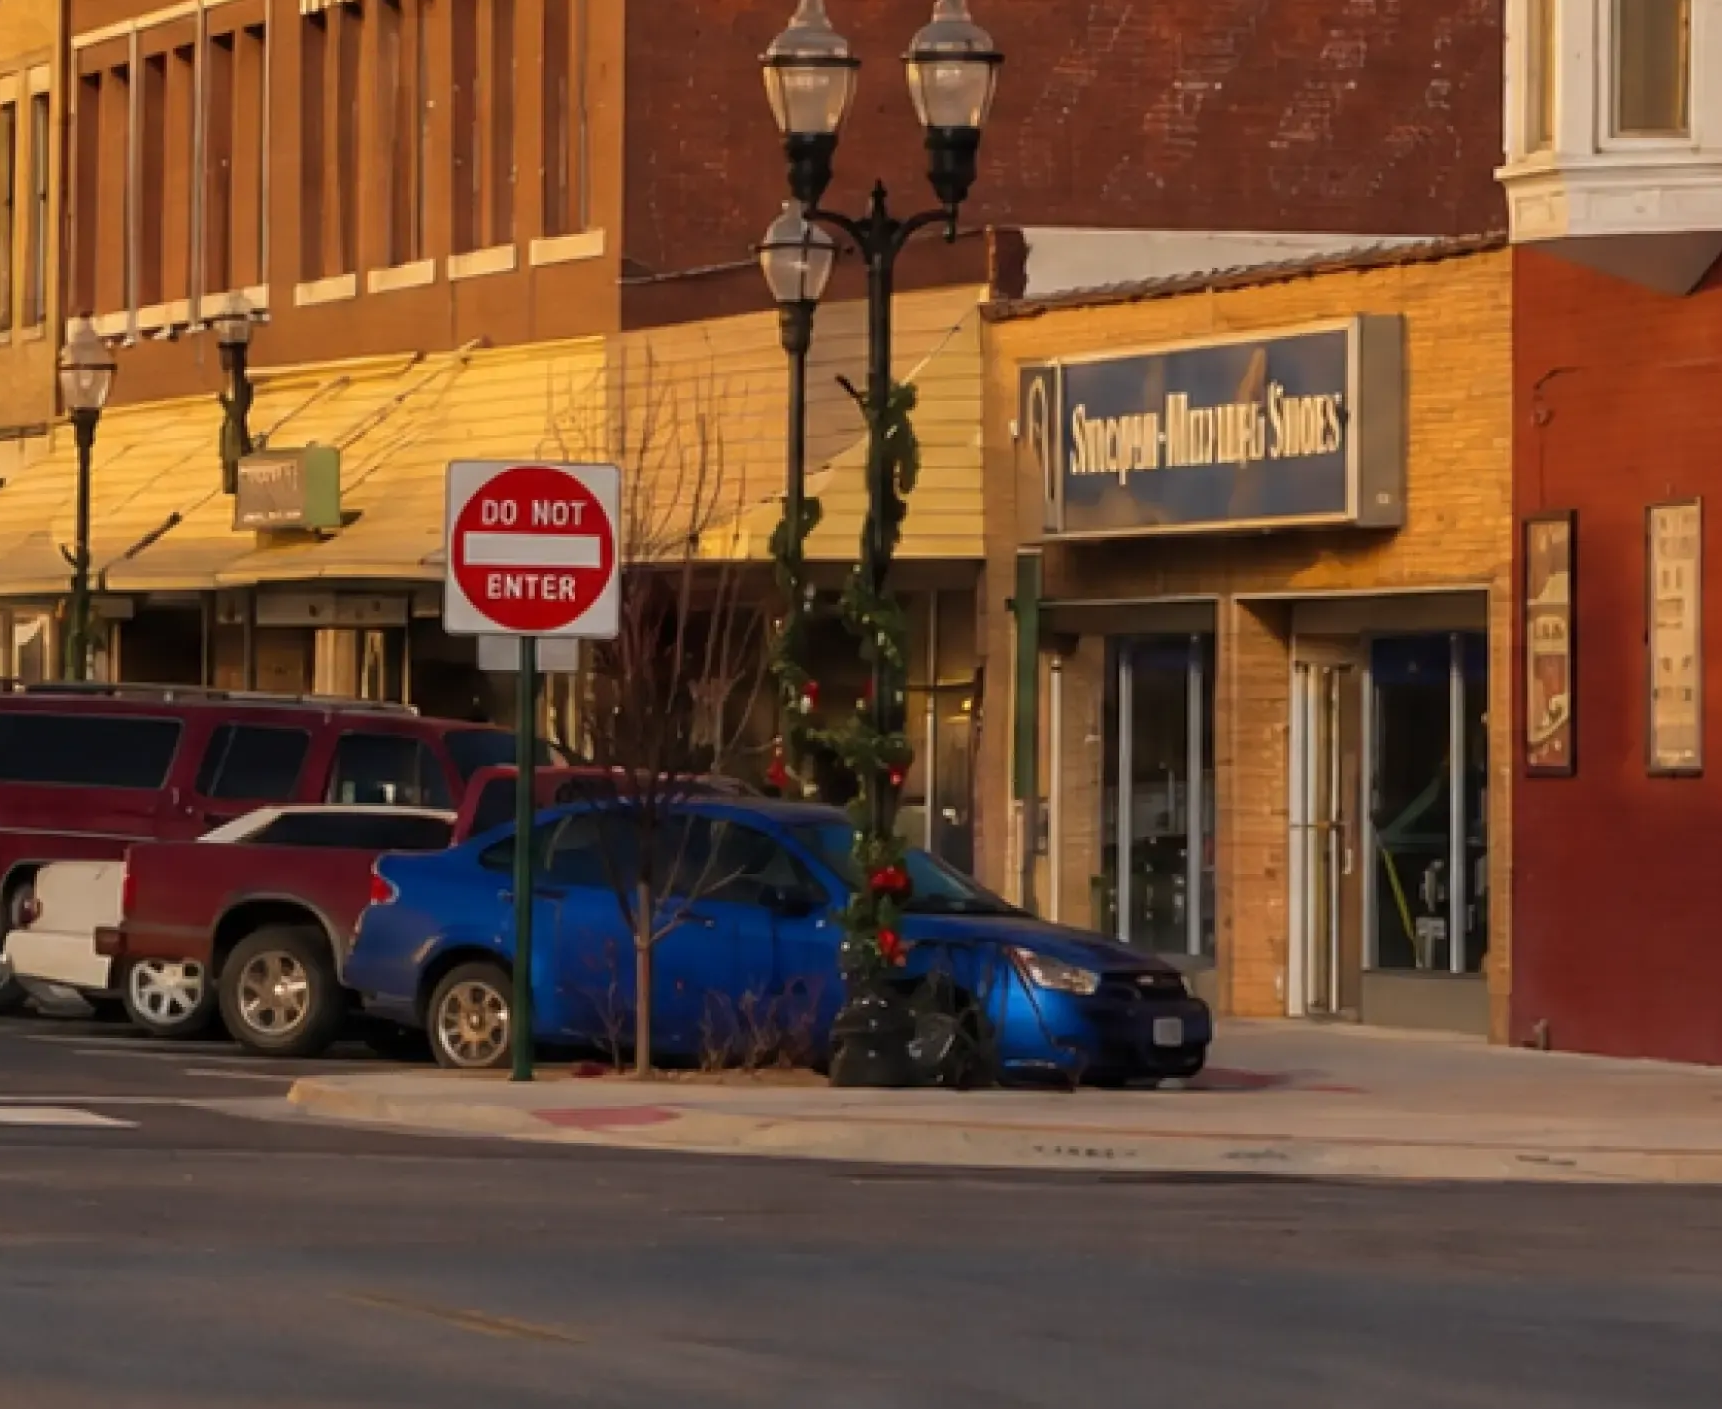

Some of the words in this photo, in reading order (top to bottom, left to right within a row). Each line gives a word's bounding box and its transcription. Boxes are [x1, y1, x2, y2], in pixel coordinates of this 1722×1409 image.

[481, 499, 518, 526] DO
[532, 499, 587, 526] NOT
[487, 574, 576, 602] ENTER
